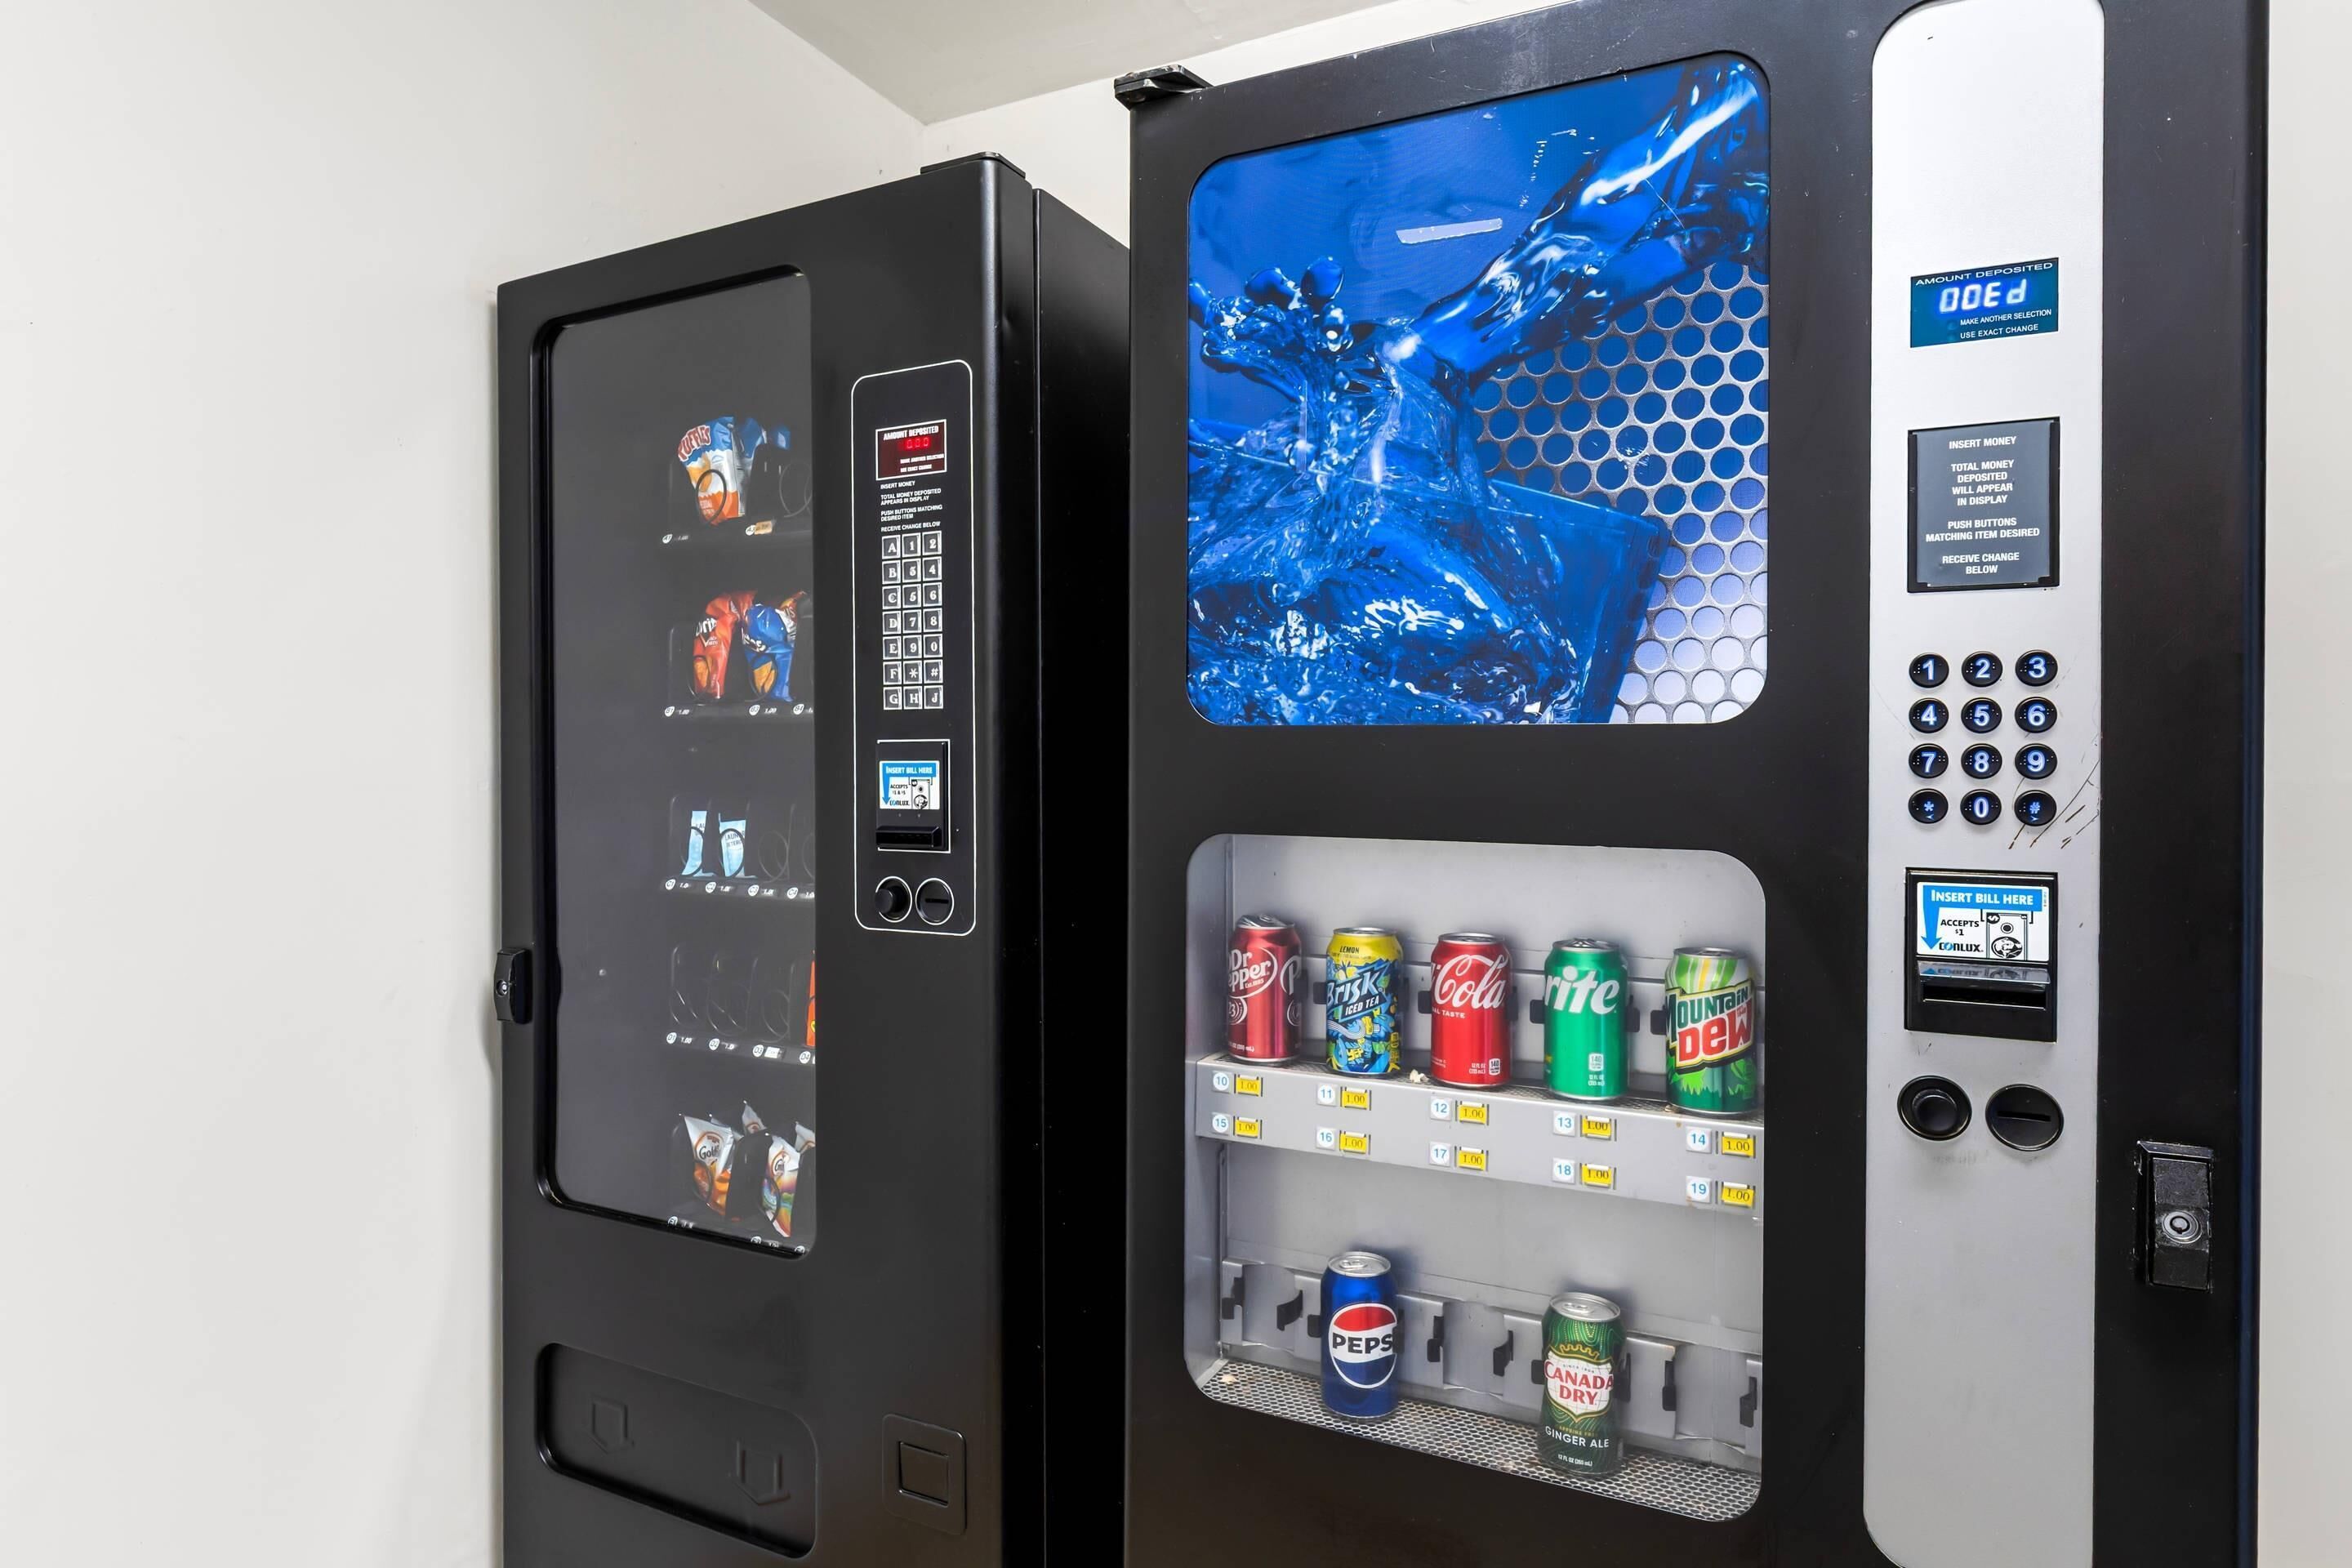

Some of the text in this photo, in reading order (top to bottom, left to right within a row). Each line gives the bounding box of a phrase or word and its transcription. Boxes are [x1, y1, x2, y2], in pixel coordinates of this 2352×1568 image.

[1915, 262, 2052, 286] AMOUNT DEPOSITED
[1960, 309, 2051, 325] MAKE ANOTHER SELECTION
[1960, 323, 2039, 339] USE EXACT CHANGE
[884, 425, 939, 440] AMOUNT DEPOSITED
[1949, 436, 2016, 449] INSERT MONEY
[1951, 460, 2014, 472] TOTAL MONEY
[1958, 471, 2007, 483] DEPOSITED
[1952, 483, 2013, 495] WILL APPEAR
[1958, 495, 2007, 506] IN DISPLAY
[1948, 517, 2016, 529] PUSH BUTTONS
[1926, 528, 2039, 542] MATCHING ITEM DESIRED
[888, 539, 937, 553] A 1 2
[1942, 552, 2020, 564] RECEIVE CHANGE
[889, 568, 897, 578] B
[929, 565, 936, 574] 4
[1966, 565, 1998, 574] BELOW
[888, 590, 937, 603] C 5 6
[889, 616, 937, 628] D 7 8
[889, 642, 938, 653] E 9 0
[890, 668, 898, 679] F
[1922, 657, 2047, 680] 1 2 3
[889, 693, 938, 704] G H J
[1921, 705, 2046, 726] 4 5 6
[1922, 751, 2046, 773] 7 8 9
[1973, 797, 1989, 817] 0
[1931, 889, 1973, 904] INSERT
[1976, 891, 2000, 904] BILL
[2003, 893, 2034, 906] HERE
[1940, 919, 1980, 928] ACCEPTS
[1340, 946, 1359, 954] LEMON
[1939, 942, 1981, 953] CONLUX
[1230, 949, 1253, 970] Dr
[1345, 996, 1379, 1016] ICED TEA
[1441, 1009, 1466, 1019] TASTE
[1216, 1076, 1258, 1091] 10 1.00
[1321, 1089, 1365, 1104] 11 1.00
[1435, 1103, 1485, 1120] 12 1.00
[1215, 1119, 1255, 1133] 15 1.00
[1557, 1117, 1608, 1131] 13 1.00
[1320, 1132, 1363, 1149] 16 1.00
[1690, 1134, 1750, 1152] 14 1.00
[1434, 1148, 1482, 1166] 17 1.00
[1557, 1165, 1609, 1181] 18 1.00
[1691, 1183, 1750, 1202] 19 1.00
[1332, 1332, 1393, 1354] PEPS
[1544, 1361, 1614, 1390] CANADA
[1560, 1385, 1598, 1405] DRY
[1545, 1426, 1586, 1447] GINGER
[1589, 1439, 1609, 1448] ALE
